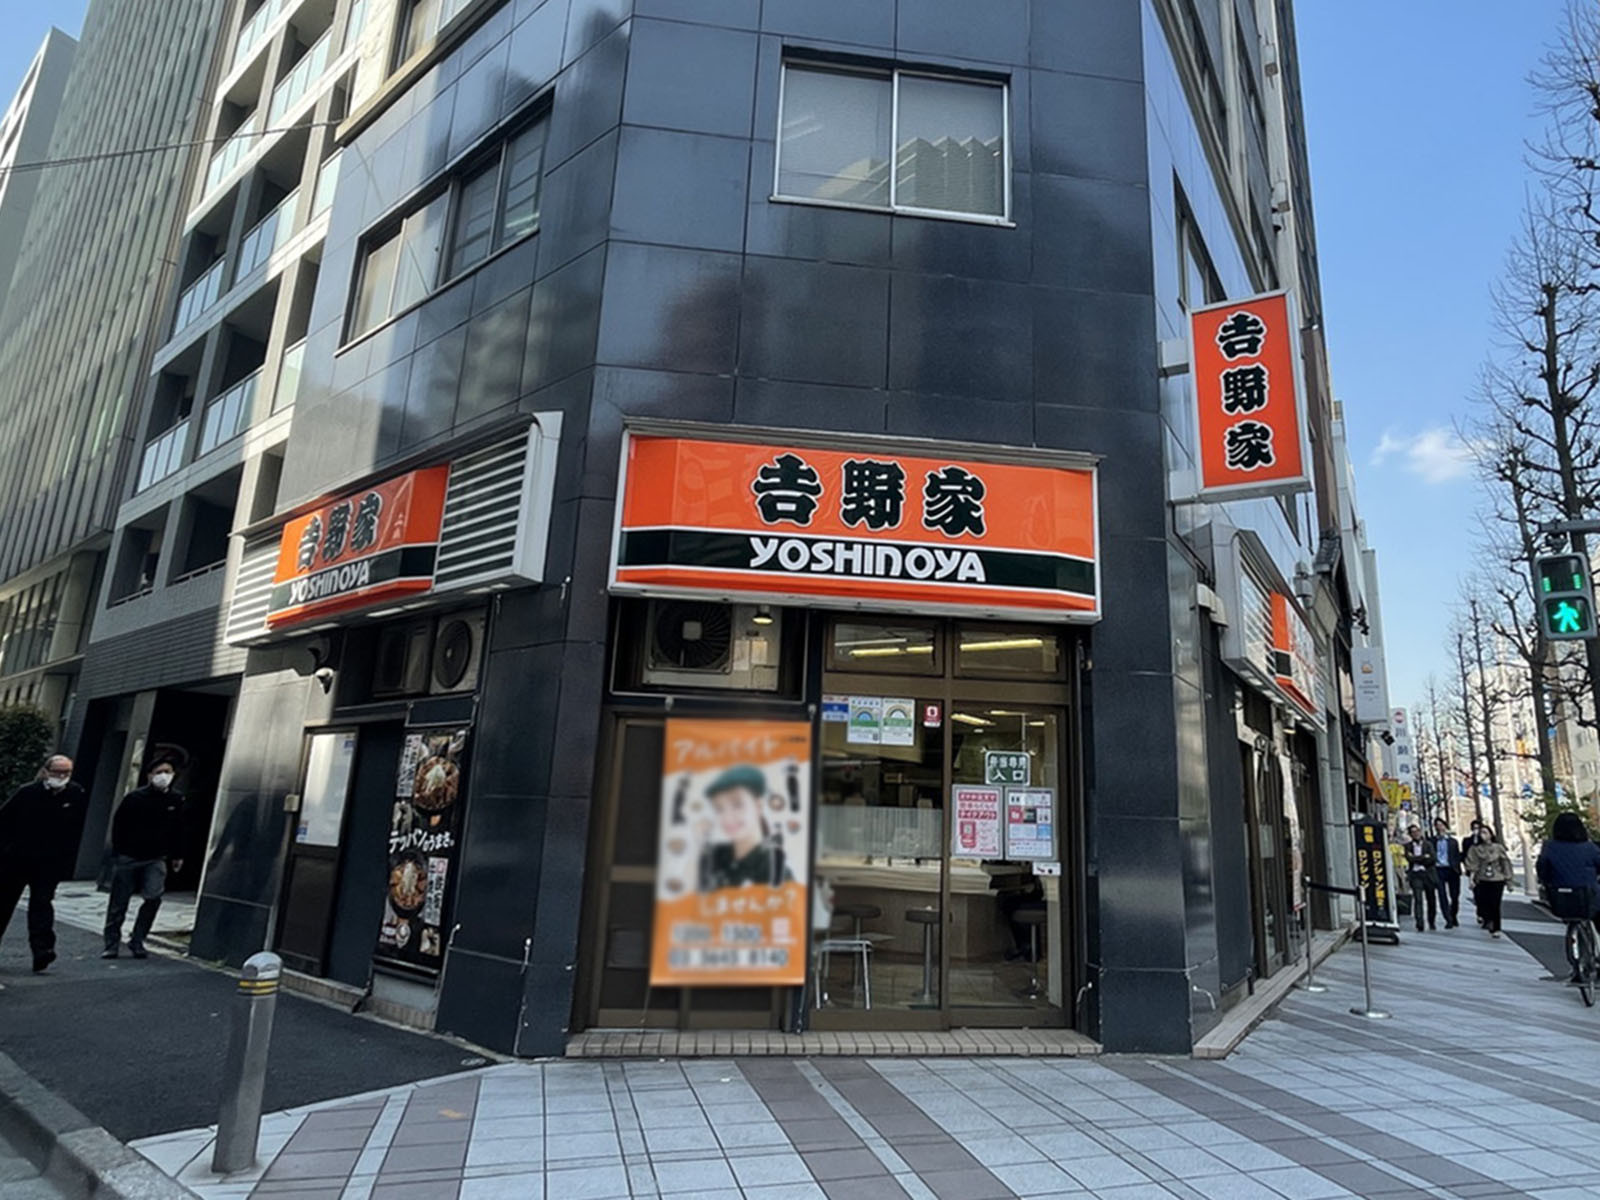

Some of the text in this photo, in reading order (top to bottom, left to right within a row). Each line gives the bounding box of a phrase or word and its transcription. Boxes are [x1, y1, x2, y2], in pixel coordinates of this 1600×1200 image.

[1216, 311, 1275, 471] 吉野家
[752, 453, 988, 537] 吉野家
[297, 491, 382, 571] 吉野家
[750, 537, 986, 582] YOSHINOYA
[289, 560, 371, 605] YOSHINOYA
[992, 769, 1024, 781] 入口
